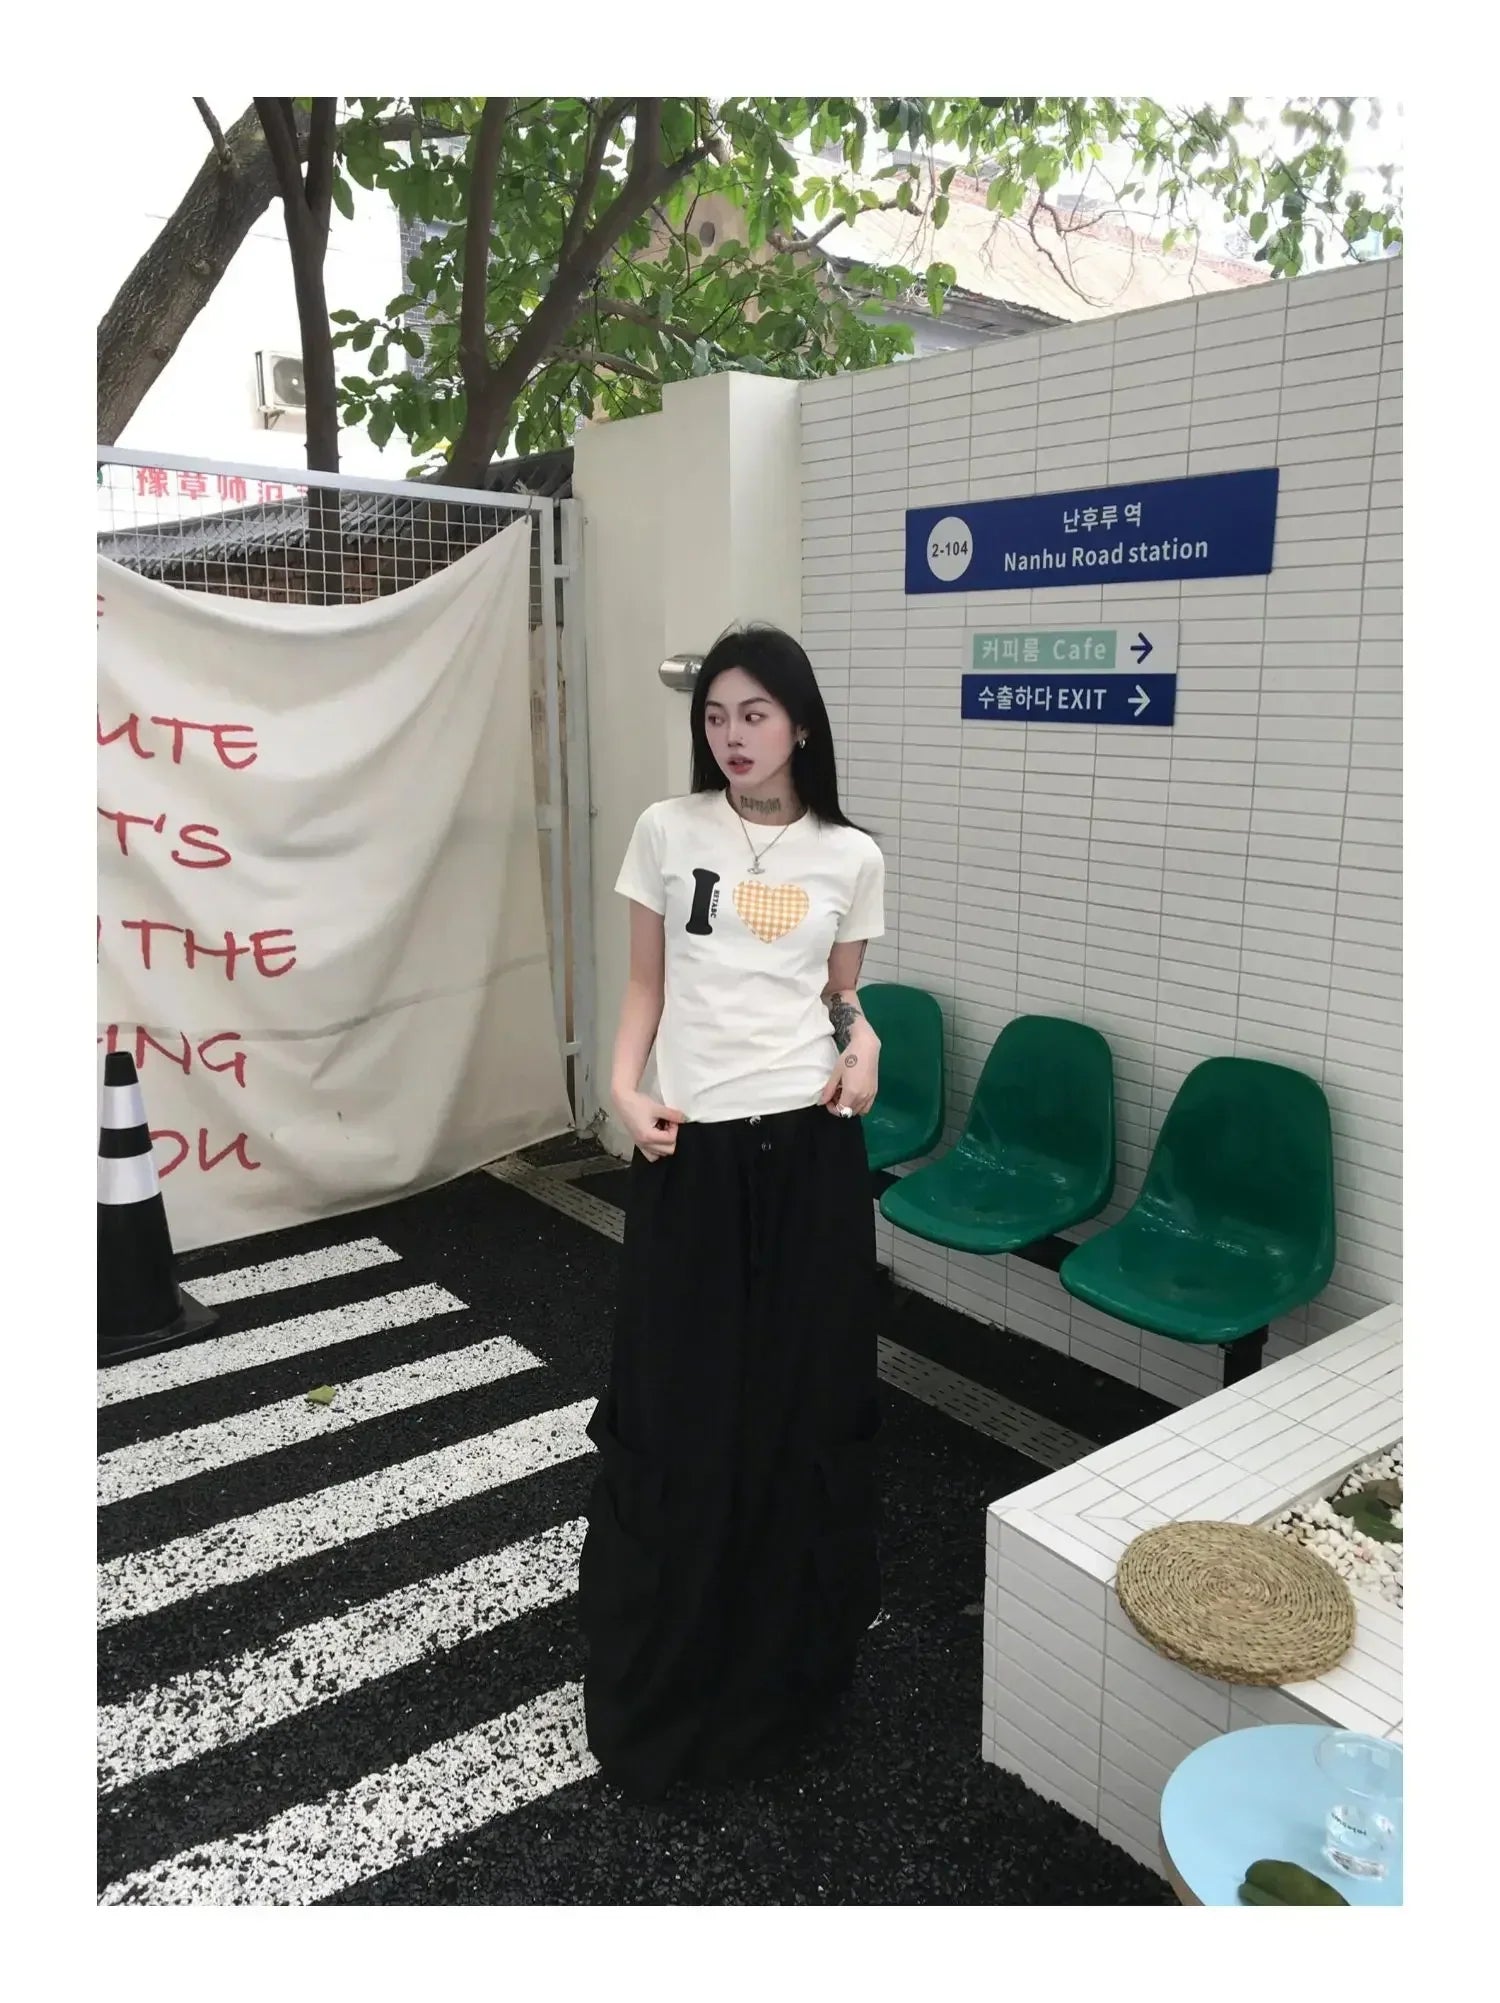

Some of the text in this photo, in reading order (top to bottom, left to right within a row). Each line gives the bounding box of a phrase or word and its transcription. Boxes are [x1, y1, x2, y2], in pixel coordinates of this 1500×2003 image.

[1063, 502, 1142, 533] 난후루 역
[932, 540, 968, 558] 2-104
[1004, 537, 1209, 572] Nanhu Road station
[981, 637, 1107, 662] 커피룸 Cafe
[978, 686, 1107, 711] 수출하다 EXIT
[685, 868, 720, 936] I
[122, 920, 296, 980] THE
[97, 1024, 246, 1088] ING
